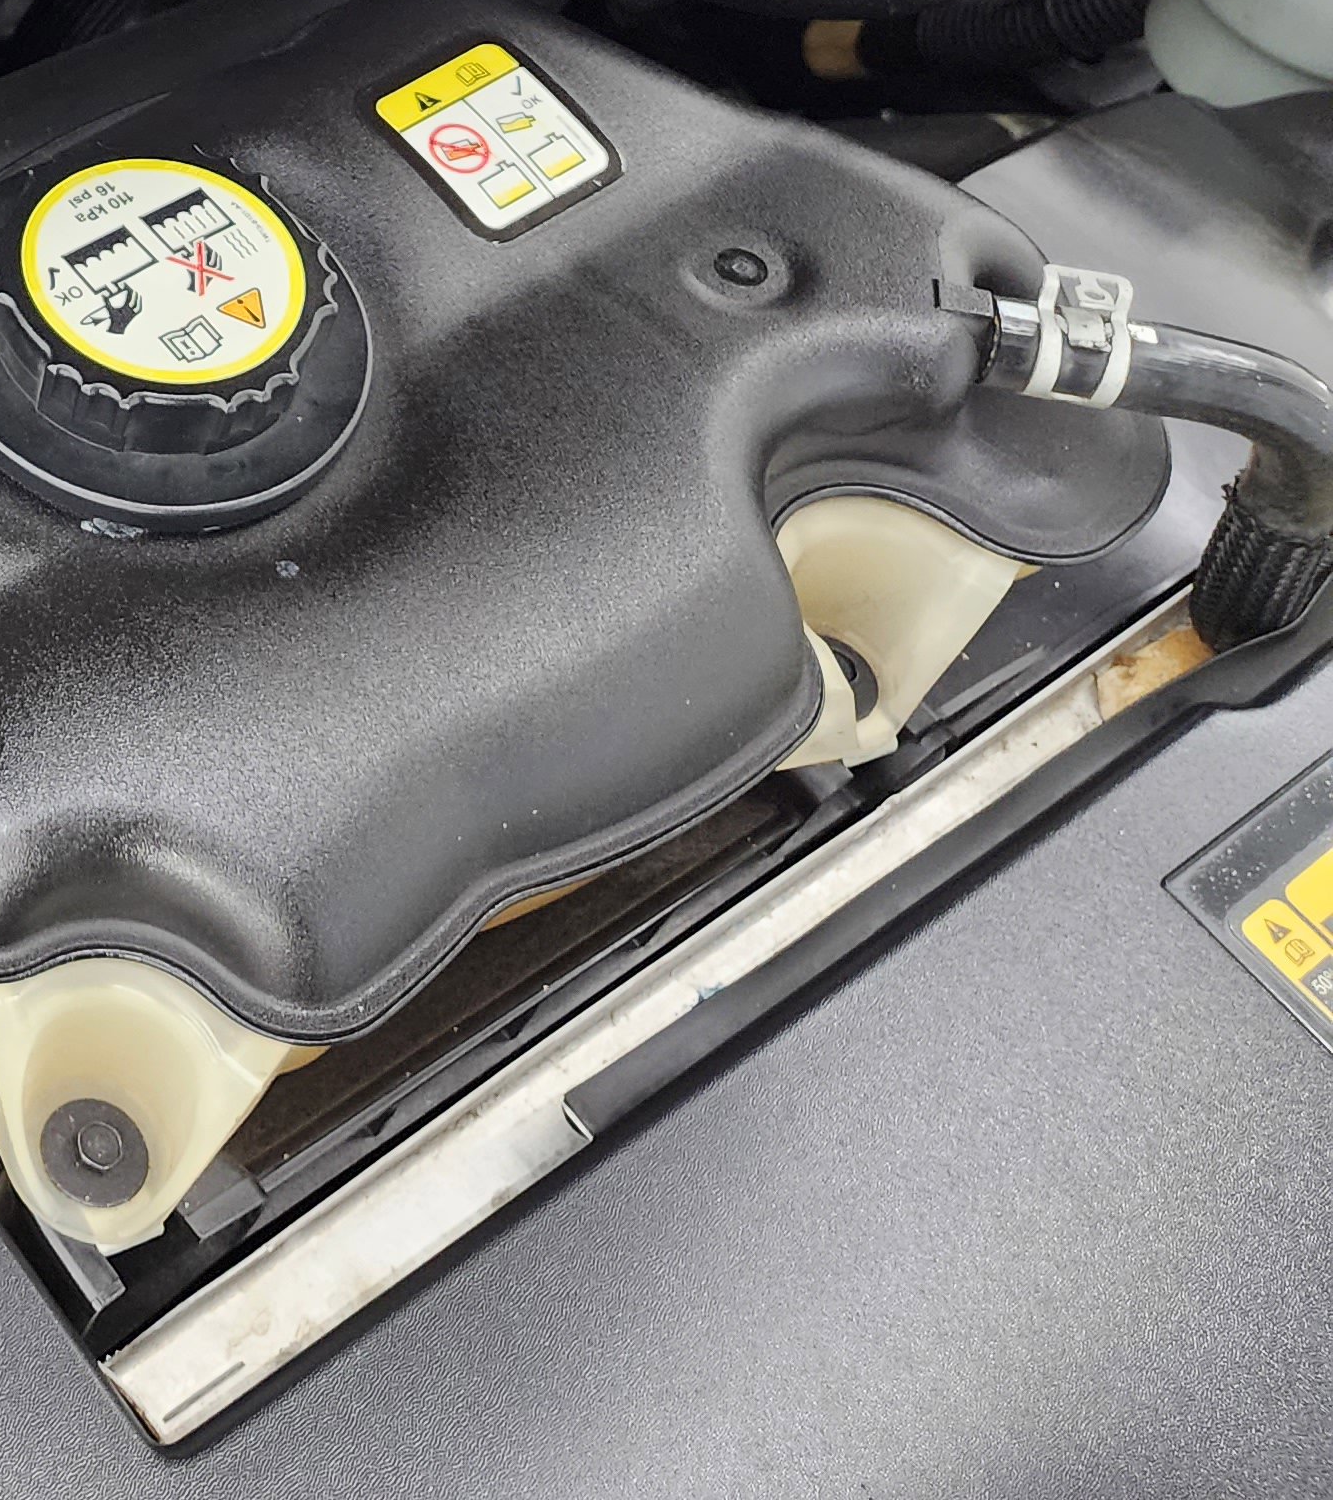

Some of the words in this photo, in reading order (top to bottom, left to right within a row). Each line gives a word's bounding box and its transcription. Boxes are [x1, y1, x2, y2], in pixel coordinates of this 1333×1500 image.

[521, 95, 543, 110] OK
[67, 188, 93, 210] psi
[98, 181, 117, 197] 16
[111, 191, 135, 211] 110
[76, 203, 110, 224] kPa
[53, 285, 84, 307] OK
